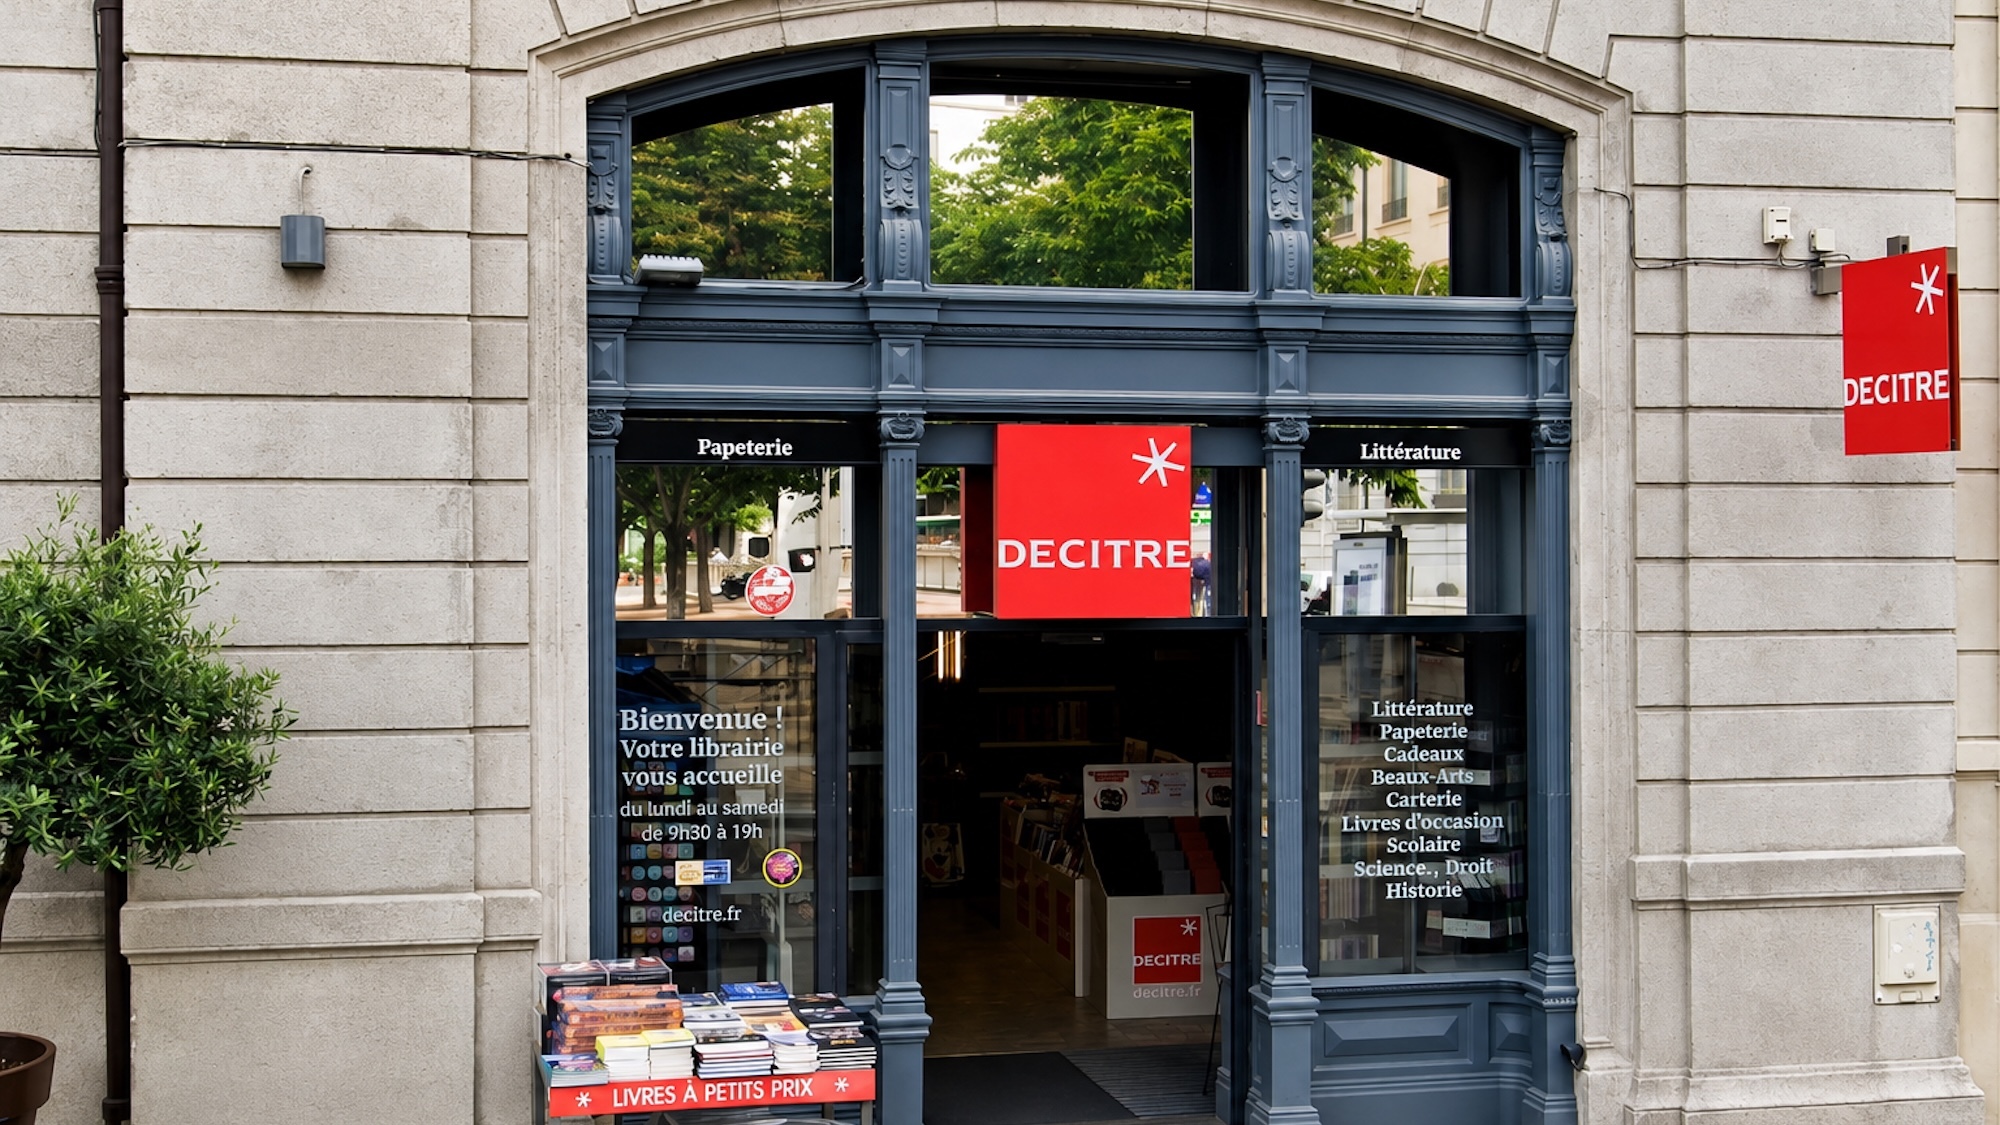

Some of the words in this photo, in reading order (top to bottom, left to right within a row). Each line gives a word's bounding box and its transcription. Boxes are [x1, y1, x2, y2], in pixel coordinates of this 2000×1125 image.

[1844, 368, 1951, 408] DECITRE
[697, 438, 793, 460] Papeterie
[1360, 442, 1462, 461] Littérature
[998, 538, 1191, 569] DECITRE
[1371, 699, 1474, 718] Littérature
[619, 707, 768, 732] Bienvenue
[775, 706, 783, 730] !
[1379, 722, 1469, 744] Papeterie
[620, 739, 684, 759] Votre
[688, 737, 784, 758] librairie
[1383, 745, 1465, 763] Cadeaux
[622, 769, 677, 787] vous
[683, 764, 783, 785] accueille
[1371, 768, 1475, 786] Beaux-Arts
[620, 801, 643, 818] du
[647, 800, 692, 817] lundi
[696, 803, 718, 816] au
[722, 799, 784, 816] samedi
[1385, 790, 1463, 808] Carterie
[1341, 815, 1402, 832] Livres
[1404, 812, 1505, 831] d'occasion
[641, 825, 663, 842] de
[668, 824, 711, 842] 9h30
[716, 823, 727, 840] à
[732, 823, 763, 840] 19h
[1386, 836, 1461, 854] Scolaire
[1445, 858, 1495, 875] Droit
[1385, 881, 1463, 900] Historie
[662, 905, 742, 924] decitre.fr
[1133, 953, 1201, 968] DECITRE
[612, 1084, 676, 1108] LIVRES
[683, 1079, 698, 1103] À
[704, 1080, 765, 1103] PETITS
[771, 1077, 814, 1098] PRIX
